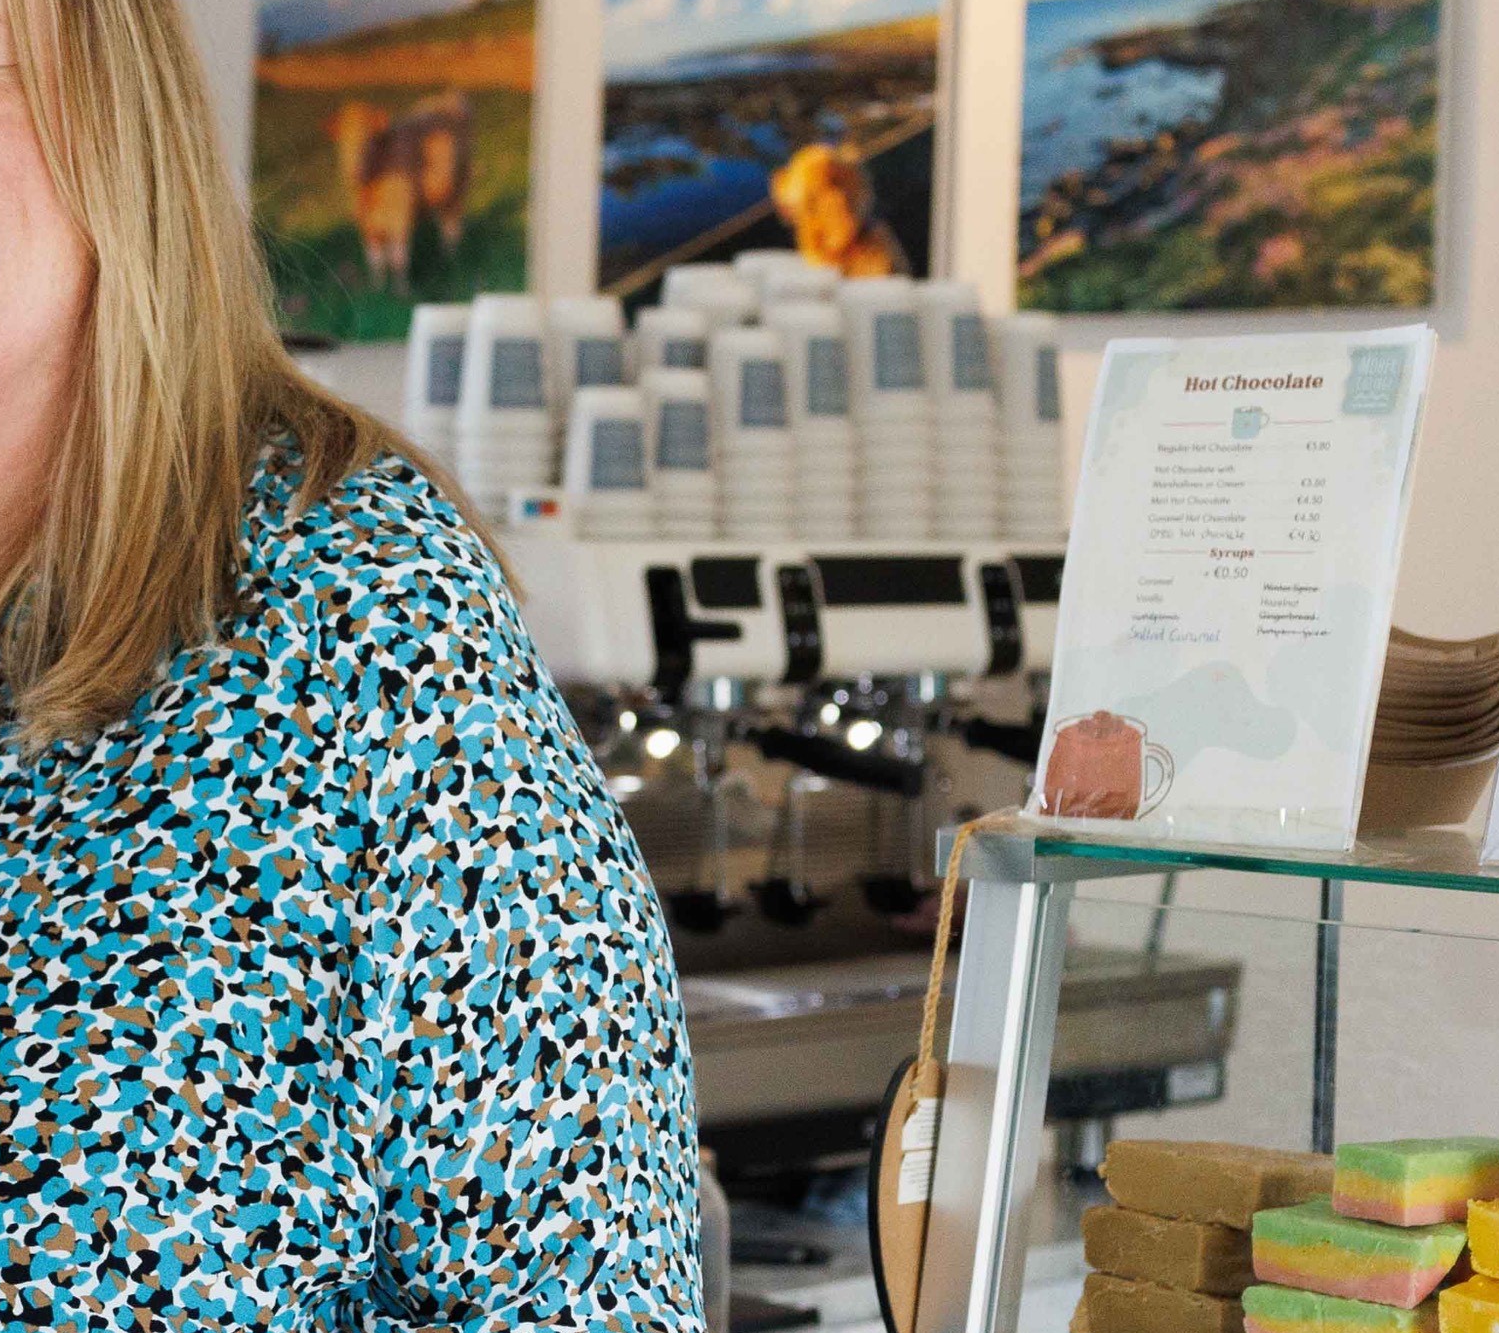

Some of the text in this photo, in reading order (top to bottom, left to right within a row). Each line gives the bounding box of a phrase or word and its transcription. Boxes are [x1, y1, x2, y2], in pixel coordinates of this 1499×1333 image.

[1184, 372, 1324, 394] Hot Chocolate
[1209, 547, 1256, 562] Syrups
[1214, 566, 1249, 580] €0.50
